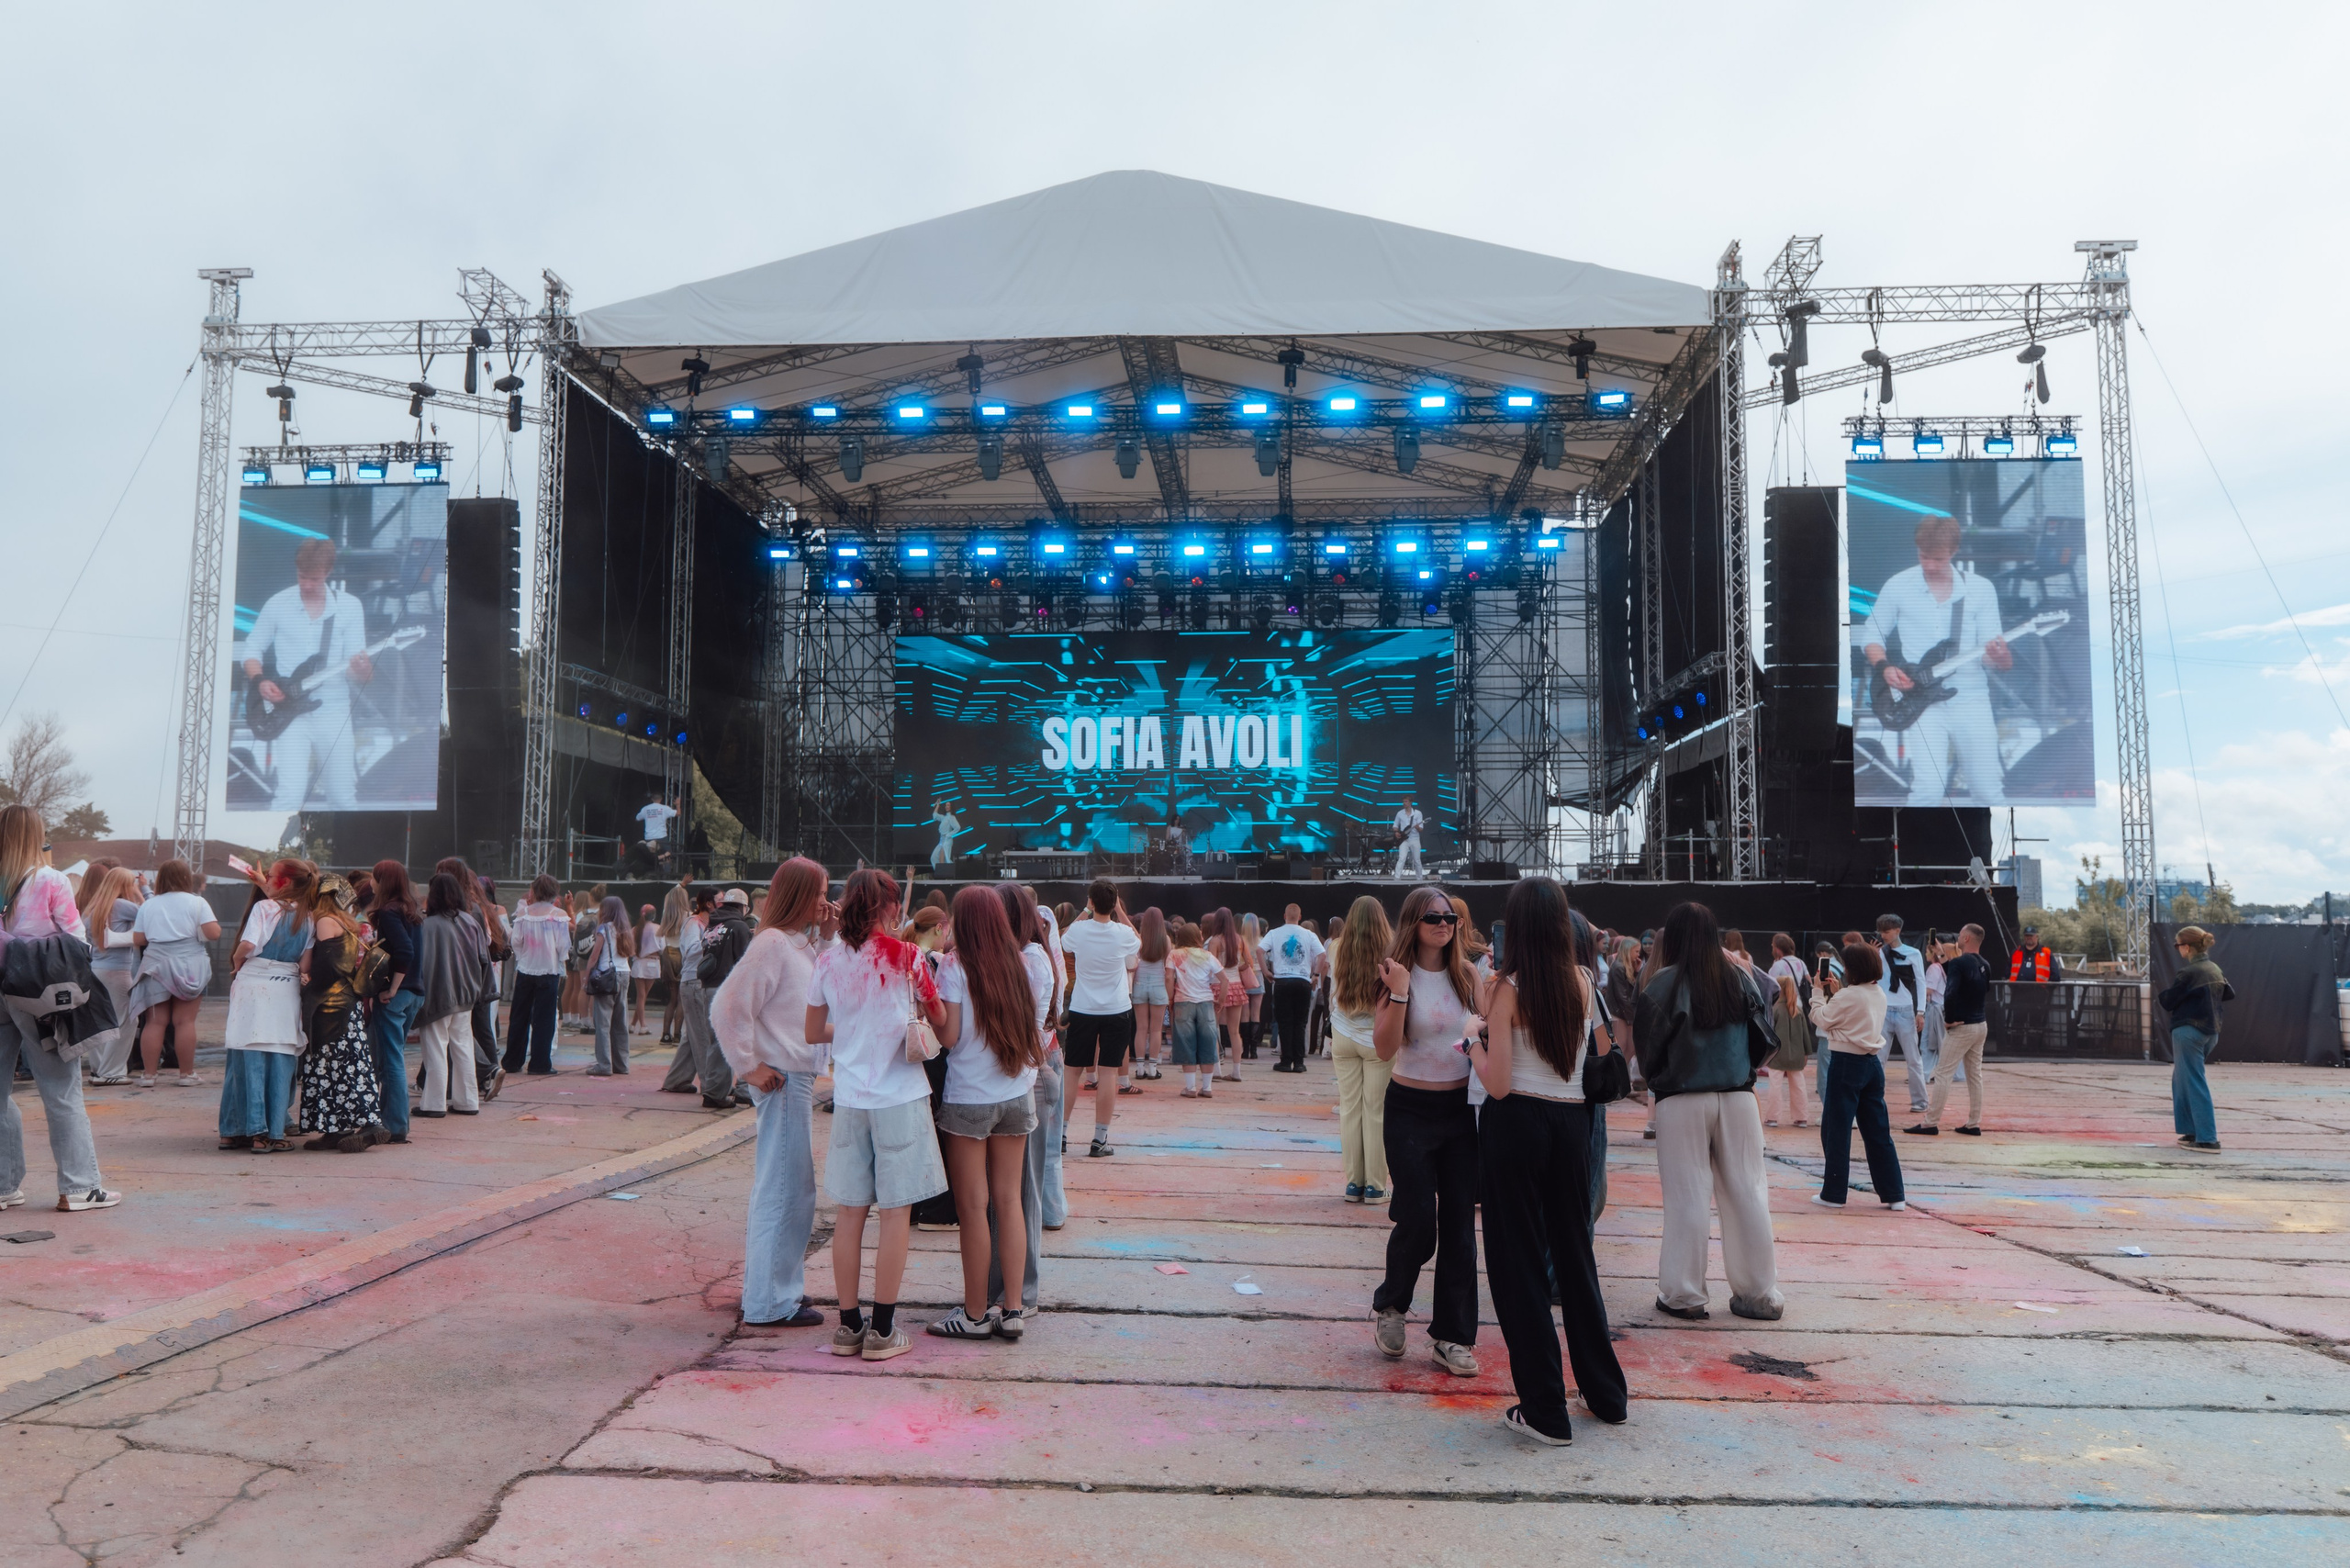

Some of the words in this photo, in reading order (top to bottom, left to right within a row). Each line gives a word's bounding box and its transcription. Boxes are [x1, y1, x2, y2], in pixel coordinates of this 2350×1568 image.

[1042, 716, 1164, 770] SOFIA
[1180, 714, 1303, 768] AVOLI
[578, 934, 596, 951] NIKE
